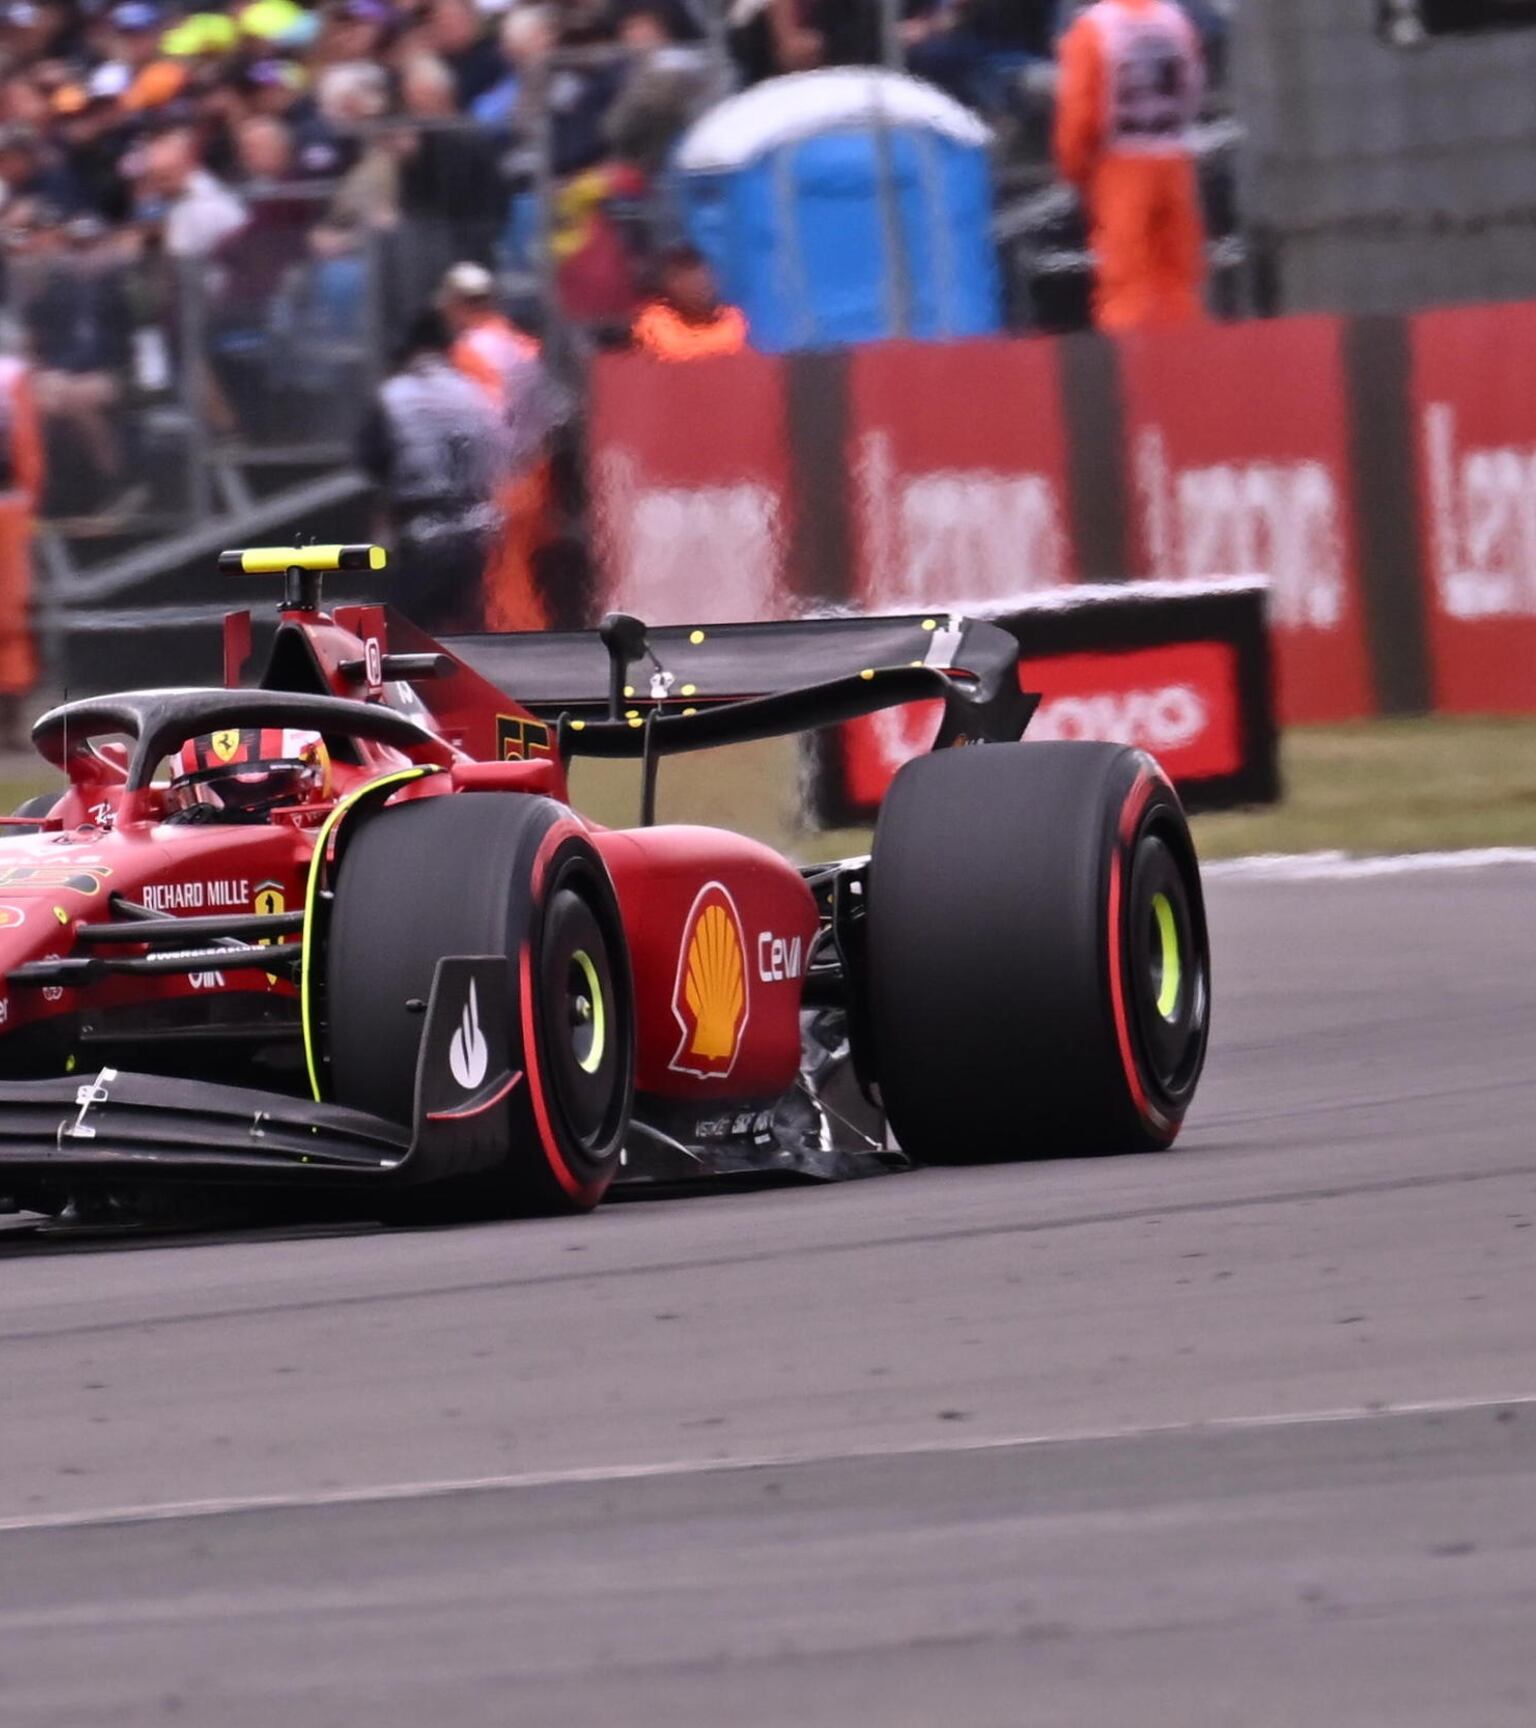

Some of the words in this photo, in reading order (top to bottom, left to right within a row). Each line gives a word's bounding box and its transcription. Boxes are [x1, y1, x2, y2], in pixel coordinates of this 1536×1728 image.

[869, 682, 1208, 768] Lovo
[143, 881, 204, 910] RICHARD
[207, 879, 249, 906] MILLE
